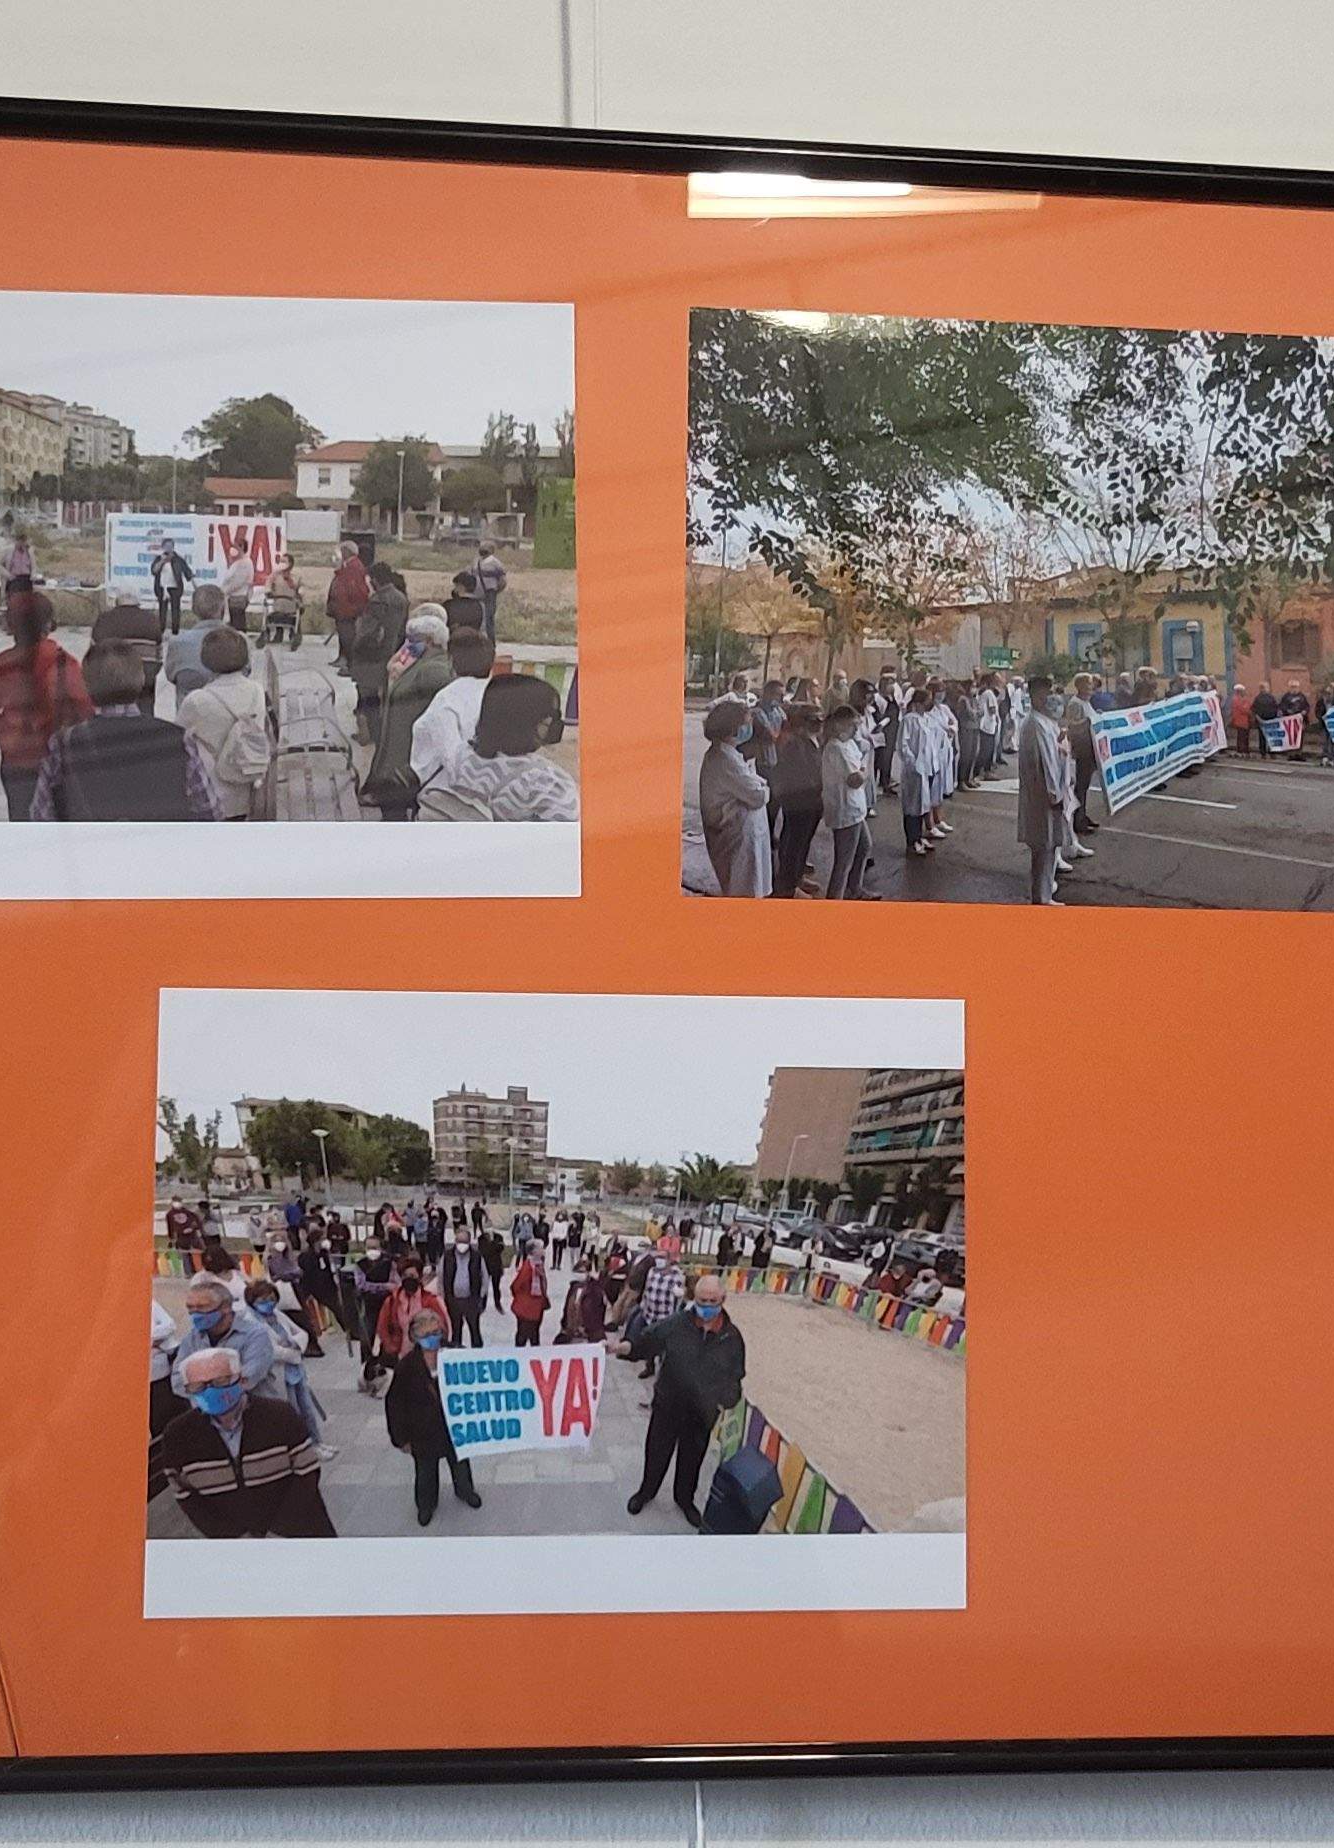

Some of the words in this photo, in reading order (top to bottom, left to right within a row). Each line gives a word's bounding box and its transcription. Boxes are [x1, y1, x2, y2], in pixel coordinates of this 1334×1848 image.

[443, 1359, 519, 1386] NUEVO
[447, 1388, 535, 1416] CENTRO
[529, 1357, 599, 1437] YA!
[451, 1418, 522, 1447] SALUD
